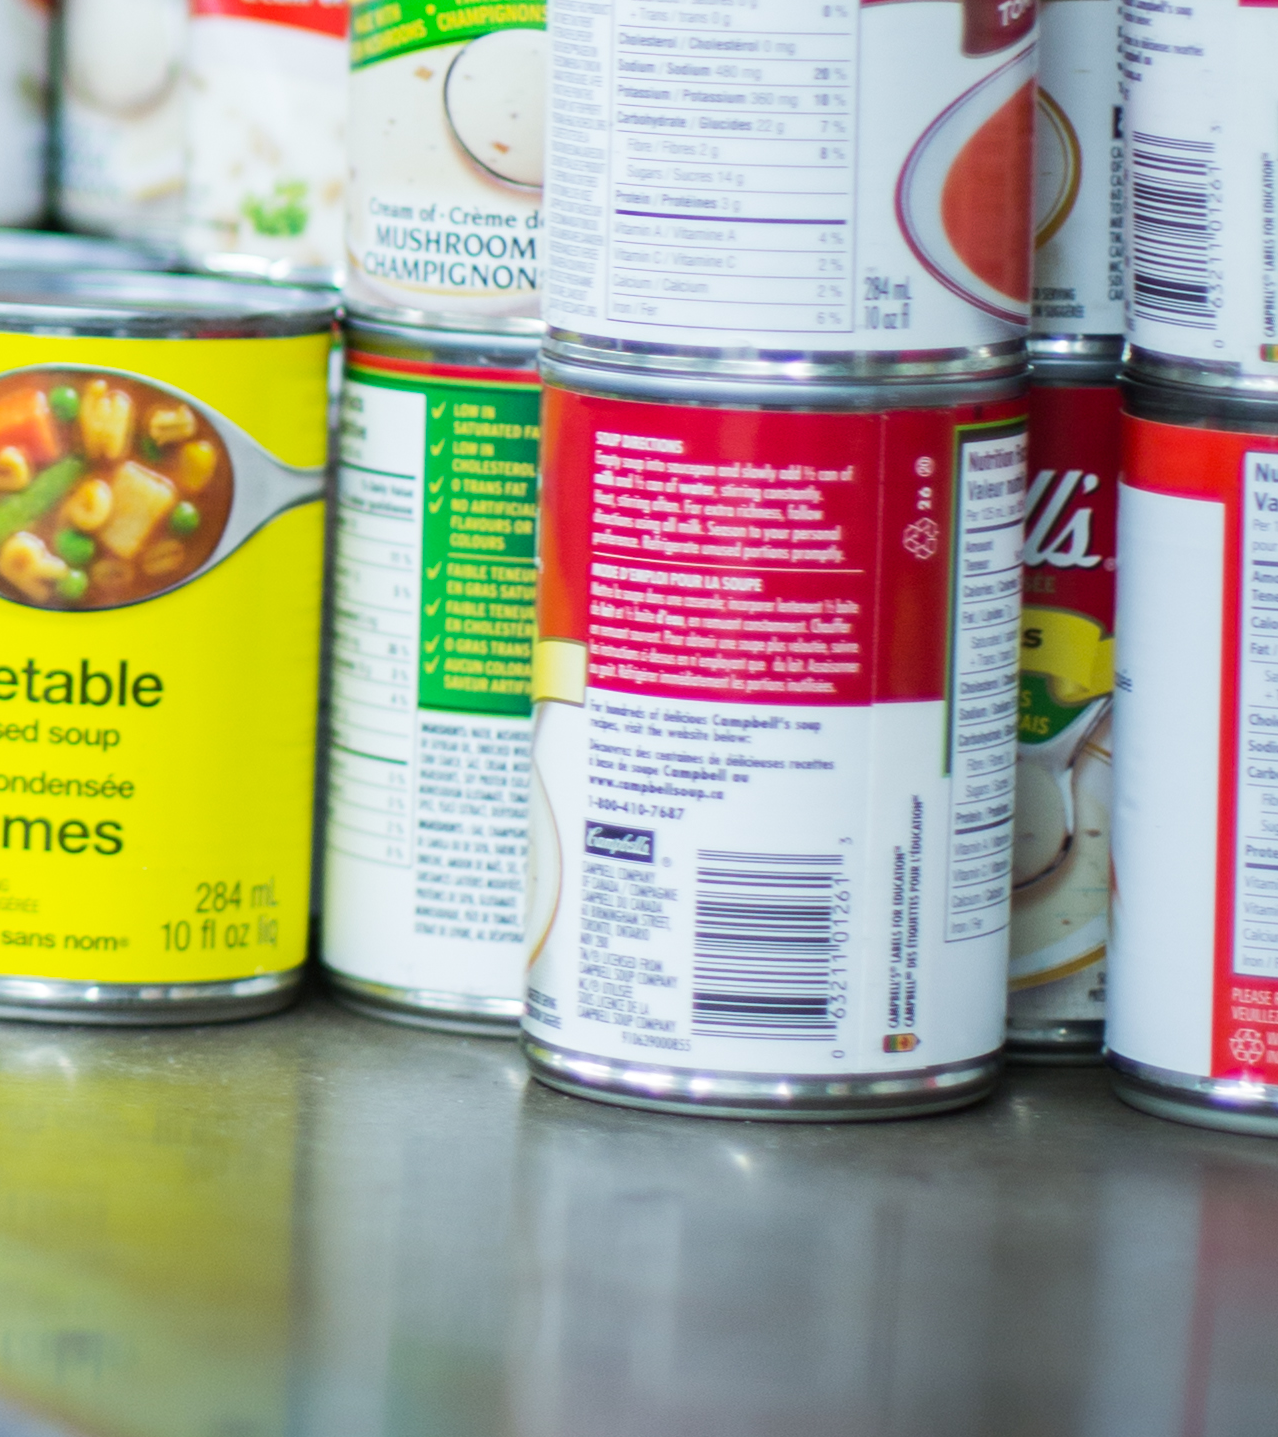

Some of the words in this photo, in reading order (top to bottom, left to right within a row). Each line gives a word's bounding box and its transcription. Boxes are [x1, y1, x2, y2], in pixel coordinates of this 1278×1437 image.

[370, 197, 413, 220] Cream
[419, 204, 436, 222] of
[449, 206, 517, 228] Crème
[376, 224, 537, 260] MUSHROOM
[453, 403, 478, 419] LOW
[481, 405, 496, 419] IN
[453, 421, 522, 439] SATURATED
[452, 441, 477, 456] LOW
[463, 479, 503, 495] TRANS
[505, 482, 528, 496] FAT
[451, 498, 468, 513] NO
[450, 516, 511, 534] FLAVOURS
[514, 520, 533, 534] OR
[449, 533, 506, 551] COLOURS
[447, 562, 487, 580] FAIBLE
[463, 582, 498, 598] GRAS
[663, 710, 707, 725] delicious
[712, 713, 791, 731] Campbell's
[795, 718, 821, 733] soup
[48, 725, 121, 751] soup
[624, 721, 643, 735] visit
[647, 723, 662, 737] the
[667, 726, 709, 742] website
[713, 729, 752, 745] below:
[636, 744, 652, 760] des
[655, 749, 704, 764] centaines
[709, 752, 721, 765] de
[726, 753, 785, 770] délicieuses
[789, 758, 834, 771] recettes
[663, 764, 727, 783] Campbell
[588, 774, 724, 800] www.campbellsoup.ca
[195, 880, 243, 913] 284
[249, 876, 279, 909] mL
[0, 929, 56, 949] sans
[161, 920, 191, 952] 10
[201, 918, 217, 949] fl
[224, 922, 250, 948] oz
